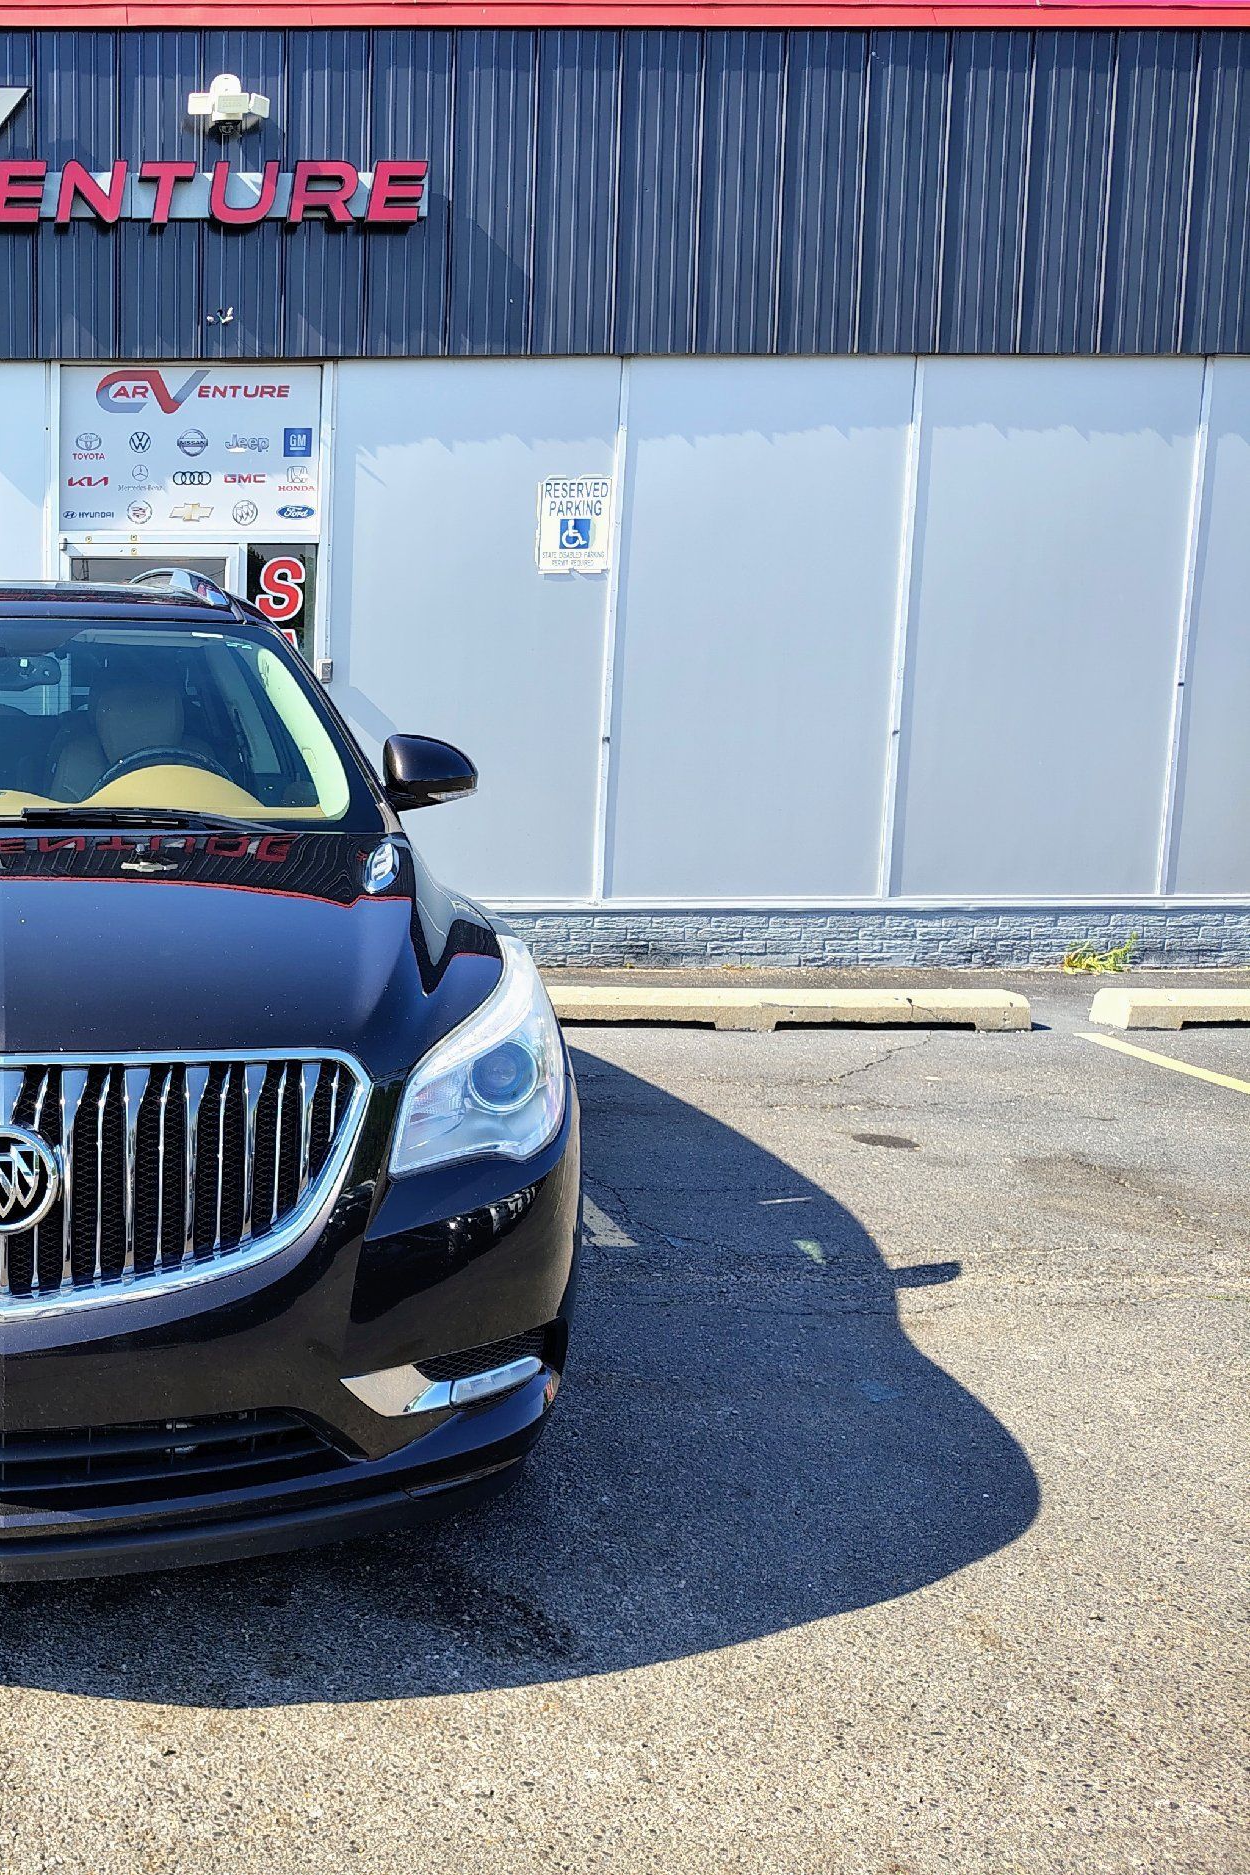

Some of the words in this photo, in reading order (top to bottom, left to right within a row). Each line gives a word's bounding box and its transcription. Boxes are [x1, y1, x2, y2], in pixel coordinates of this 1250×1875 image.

[225, 434, 269, 452] Jeep
[289, 434, 307, 447] GM
[224, 474, 266, 484] GMC
[545, 482, 609, 498] RESERVED
[283, 508, 310, 517] Ford
[549, 500, 602, 516] PARKING
[78, 511, 114, 519] HYUNDAI
